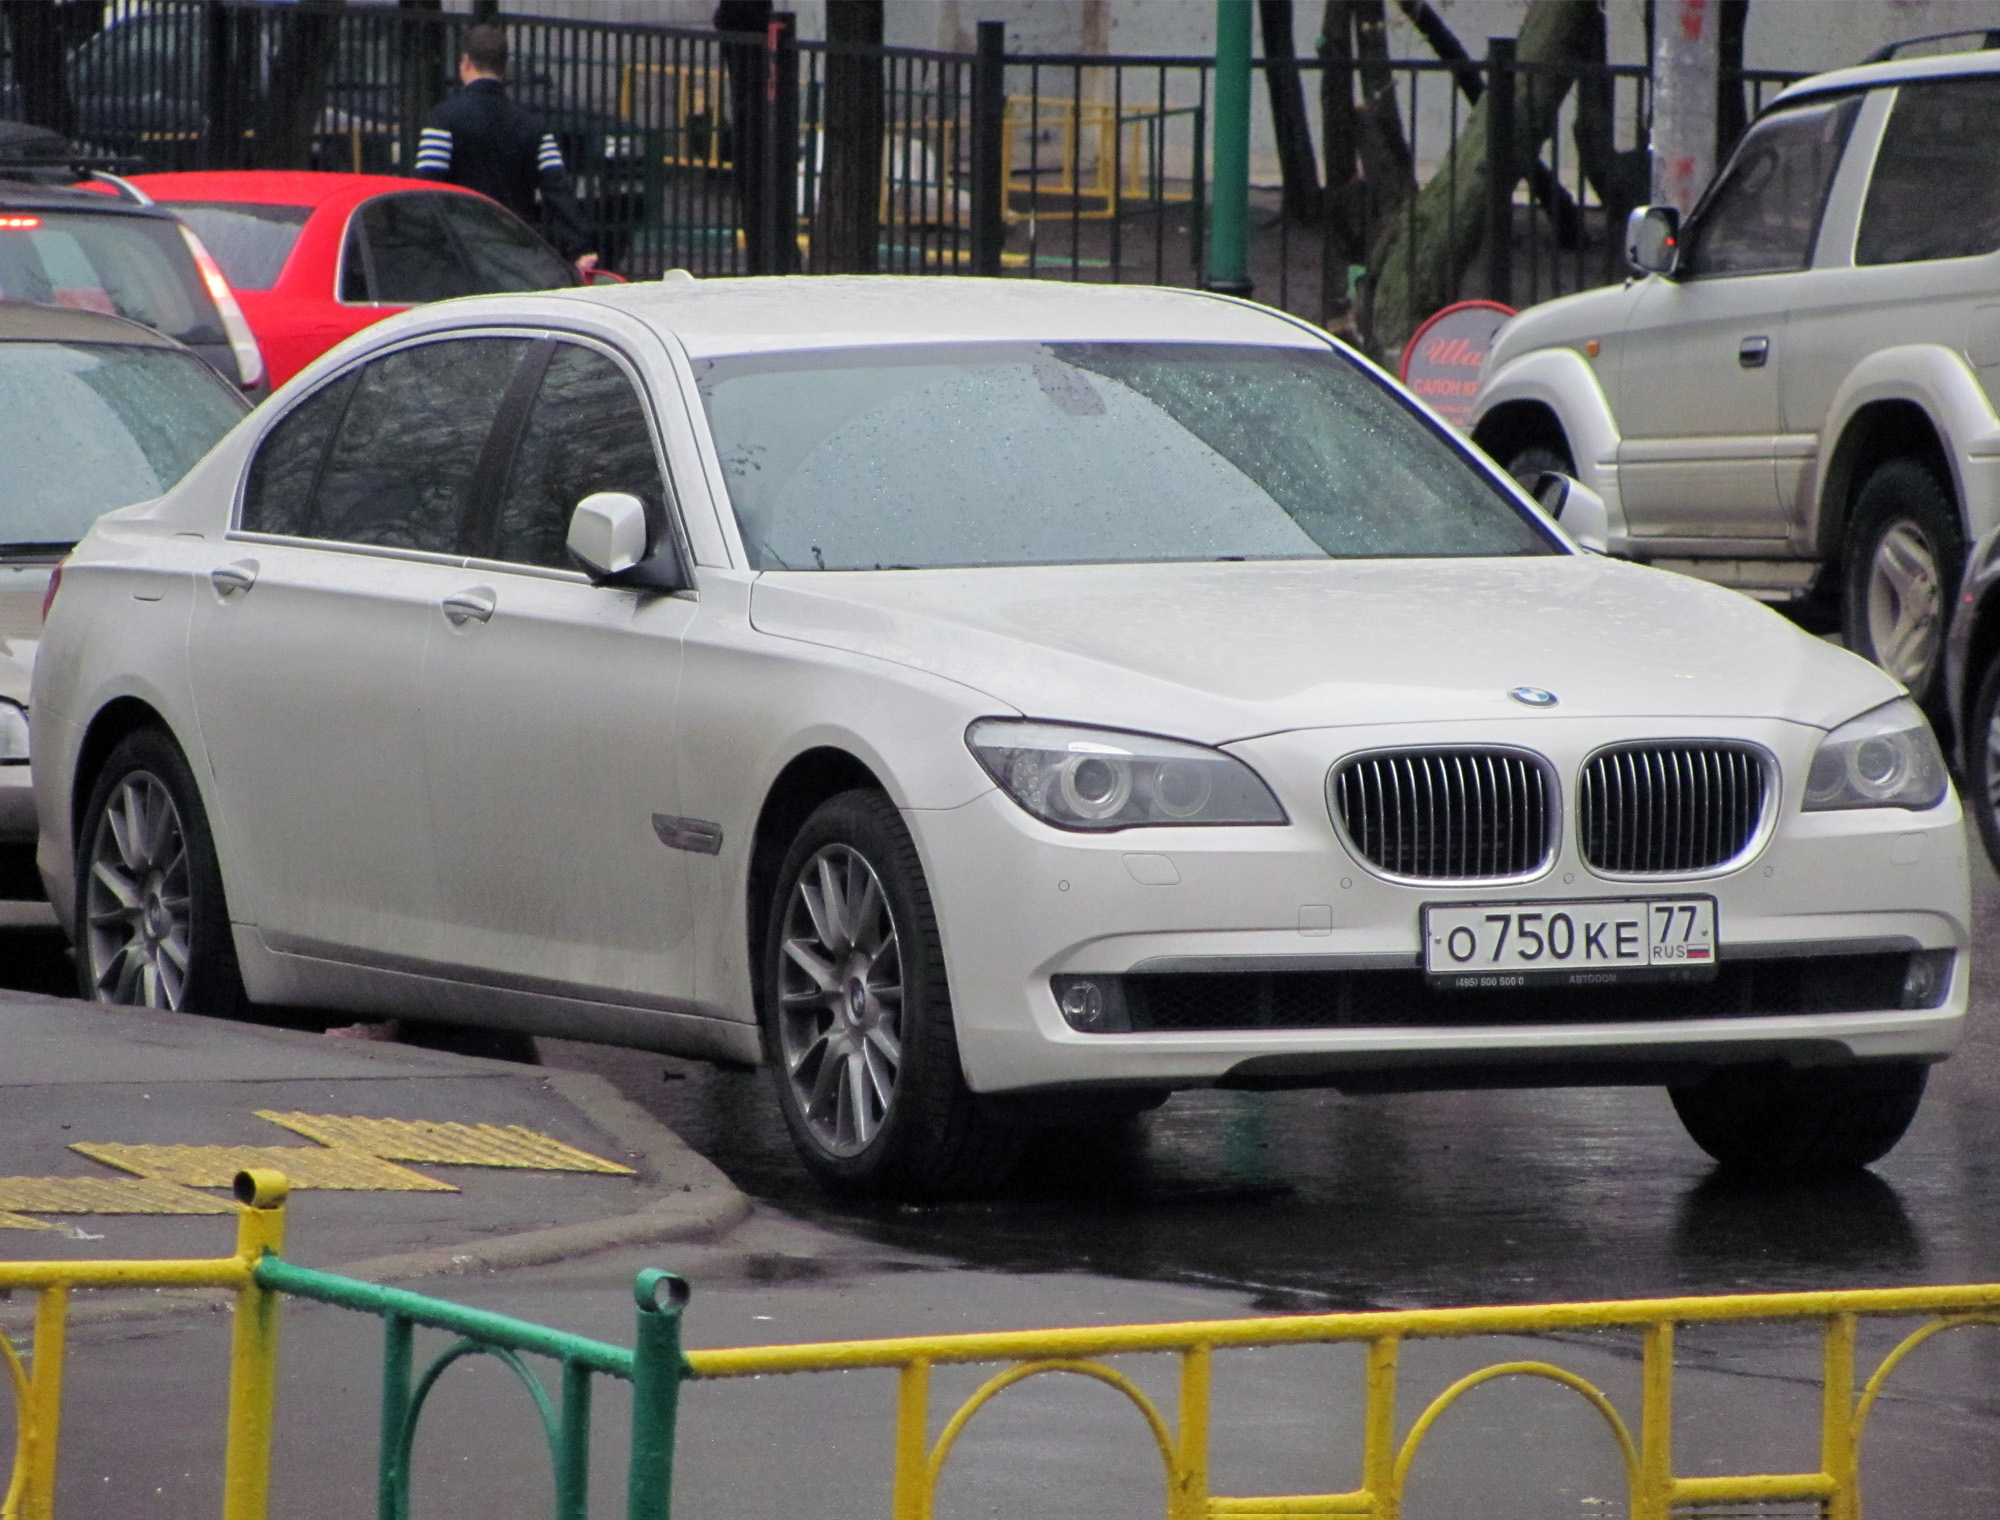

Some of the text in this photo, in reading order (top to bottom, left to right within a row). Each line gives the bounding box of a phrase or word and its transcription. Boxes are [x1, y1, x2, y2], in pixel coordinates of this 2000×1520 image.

[1413, 379, 1461, 395] САЛОН
[1655, 905, 1697, 943] 77
[1653, 945, 1686, 959] RUS
[1455, 977, 1478, 987] (495)
[1499, 976, 1516, 986] 500
